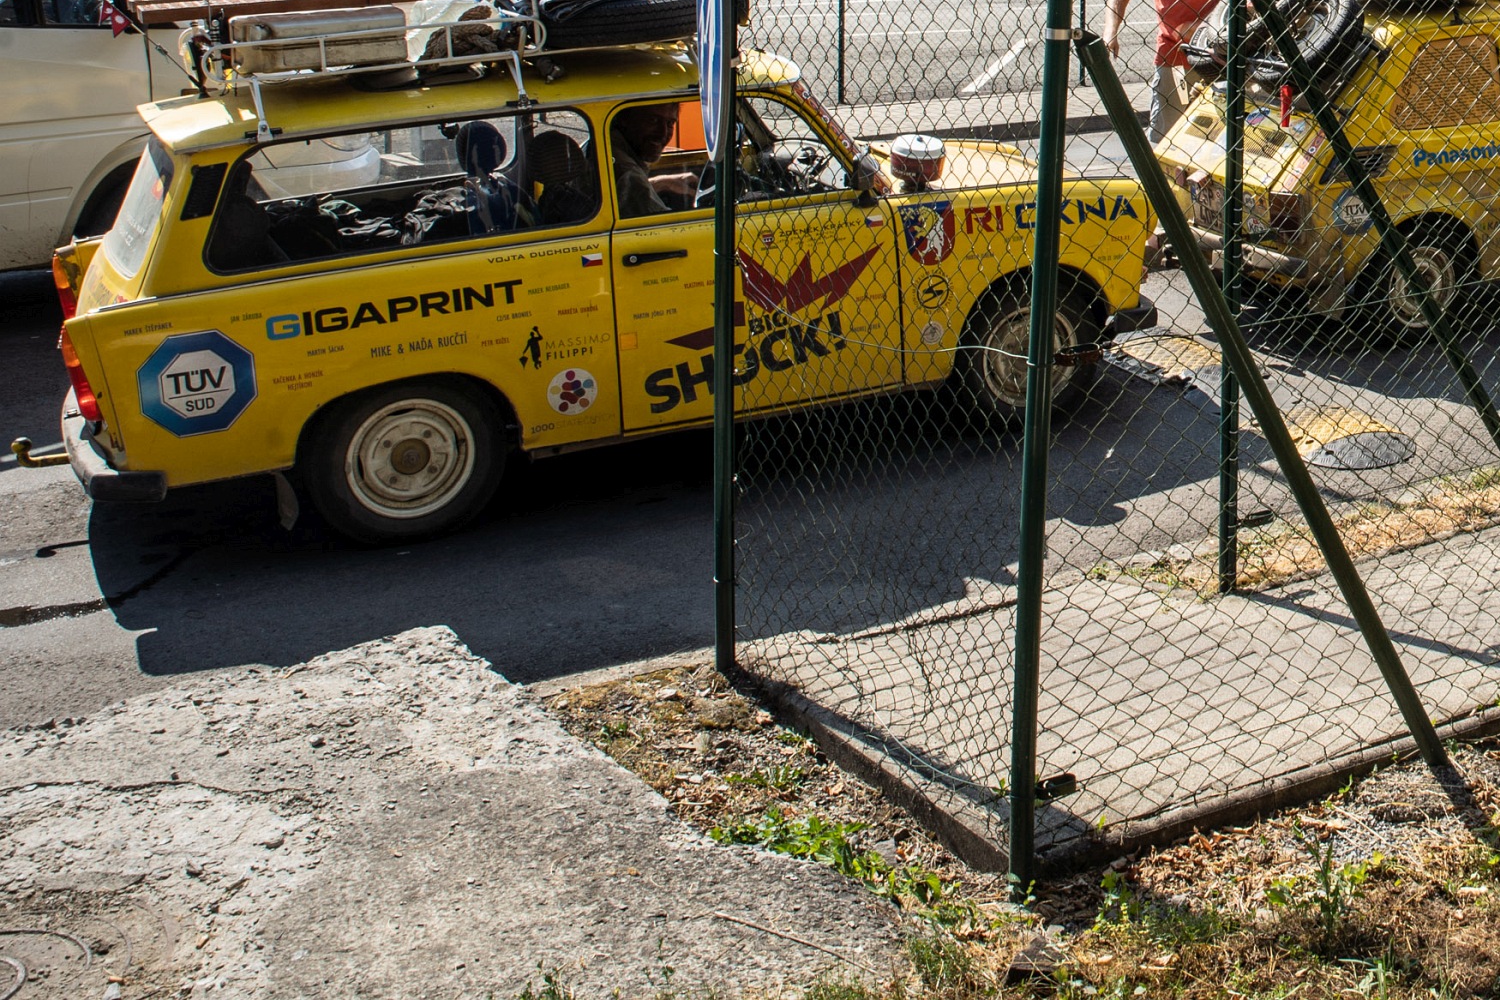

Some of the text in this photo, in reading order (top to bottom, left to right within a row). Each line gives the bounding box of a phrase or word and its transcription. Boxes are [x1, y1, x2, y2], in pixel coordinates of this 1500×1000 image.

[964, 205, 1003, 234] RI
[487, 243, 600, 264] VOJTA DUCHOSLAV
[266, 279, 523, 341] GIGAPRINT
[124, 327, 143, 337] MAREK
[748, 310, 788, 336] BIG
[545, 332, 611, 350] MASSIMO
[370, 344, 392, 359] MIKE
[397, 343, 405, 355] &
[546, 346, 594, 361] FILIPPI
[644, 311, 847, 414] SHOCK!
[166, 365, 227, 395] TÜV
[185, 397, 215, 412] SÜD
[530, 422, 556, 435] 1000
